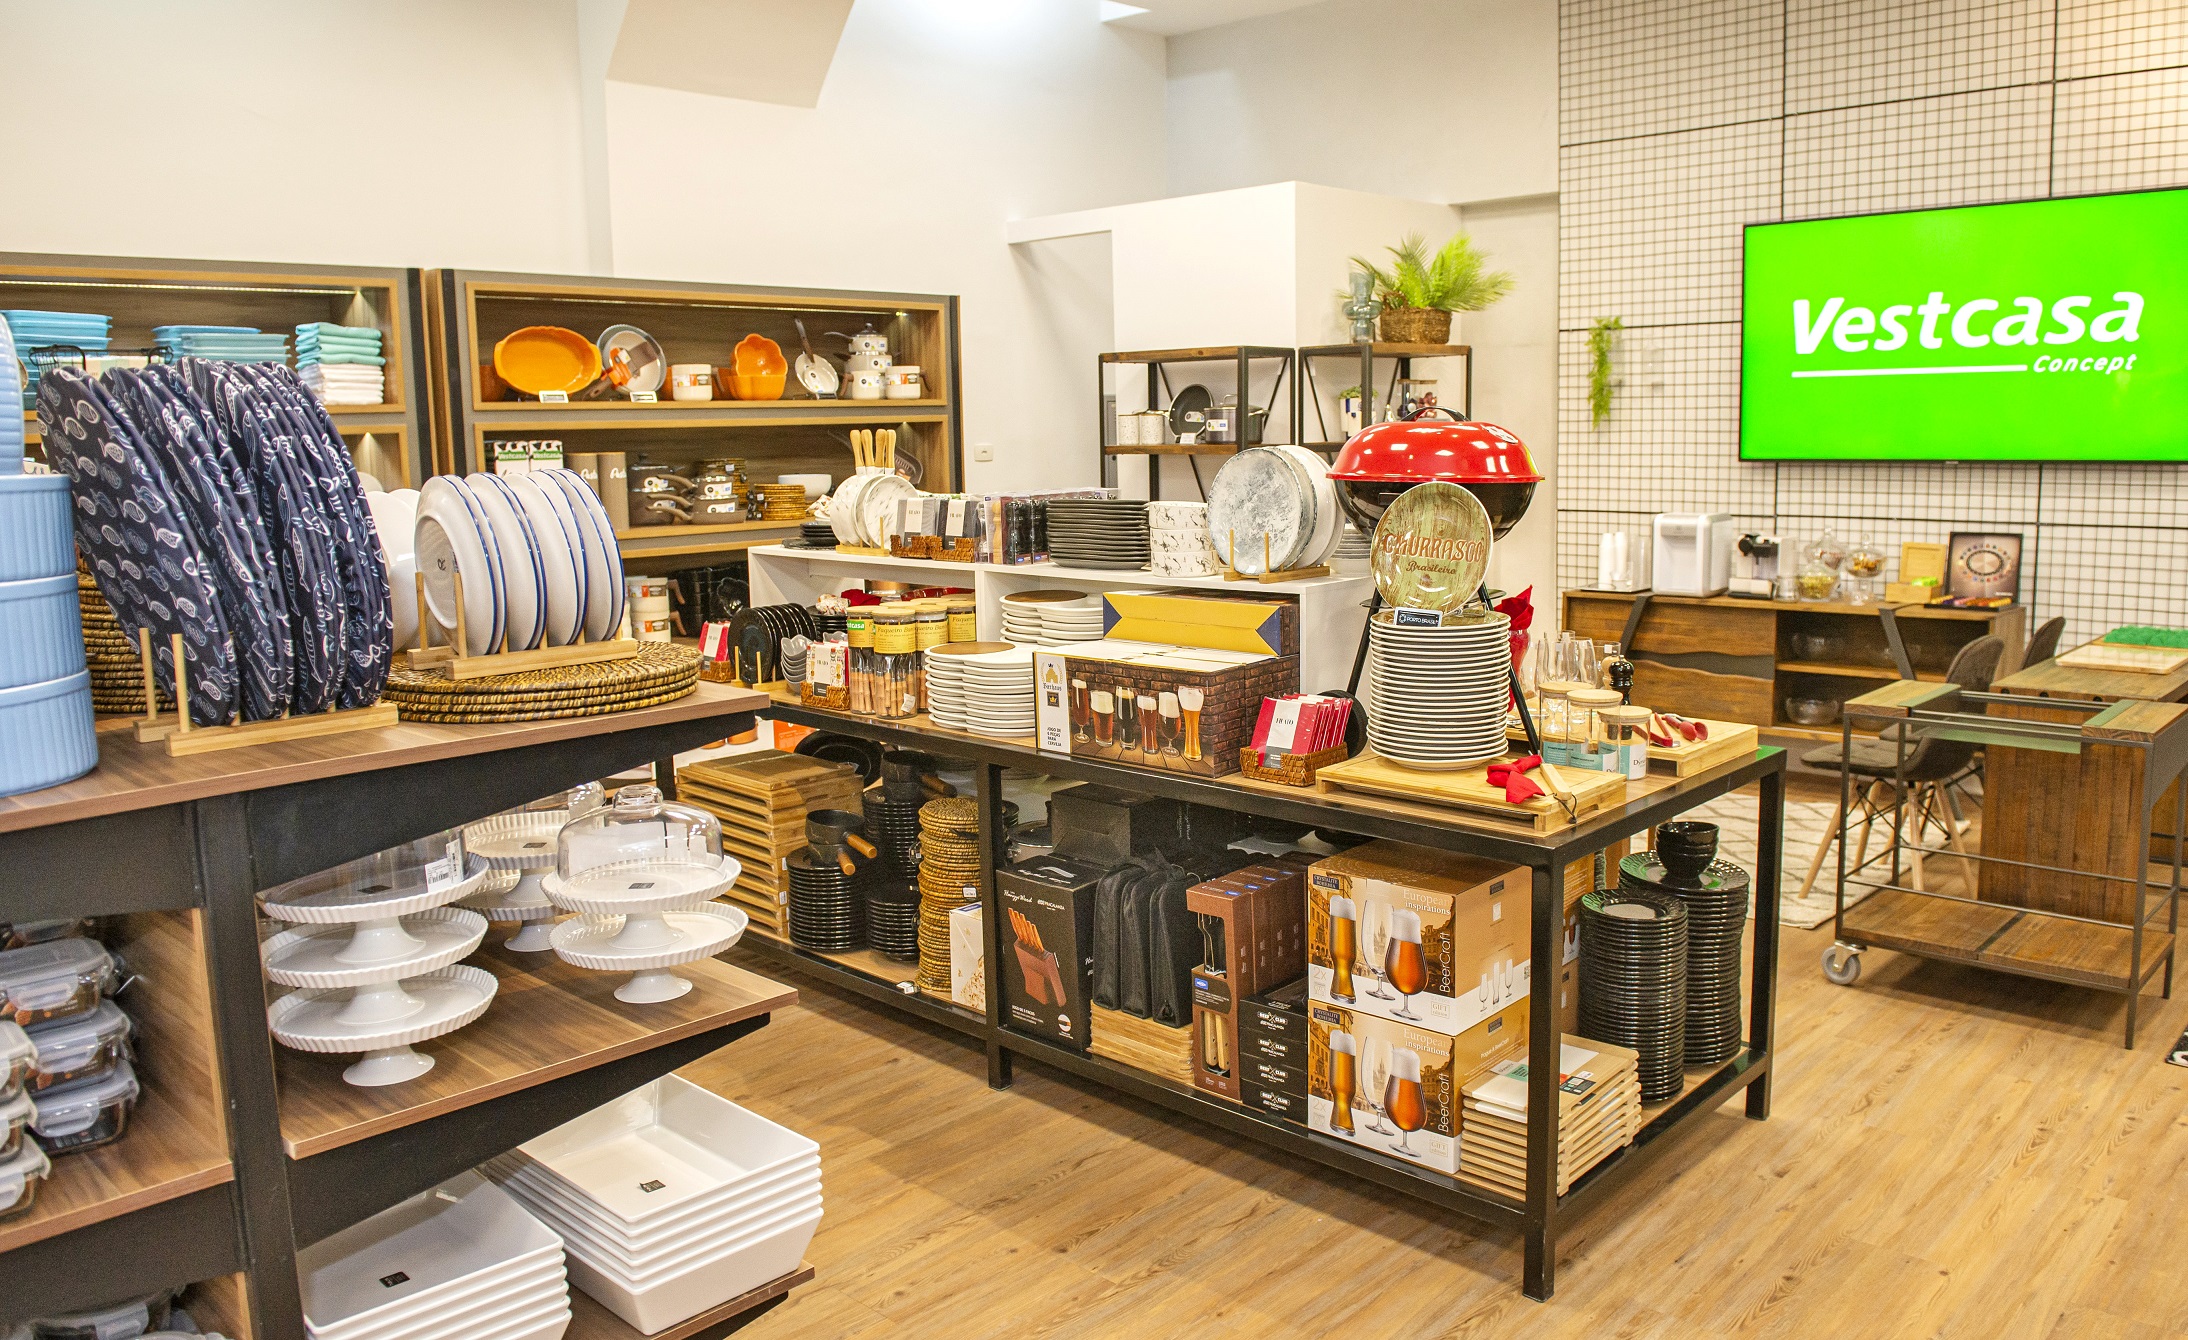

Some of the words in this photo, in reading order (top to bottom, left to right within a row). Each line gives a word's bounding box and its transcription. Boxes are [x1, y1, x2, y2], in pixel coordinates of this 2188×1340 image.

[1793, 291, 2145, 355] Vestcasa
[2033, 353, 2138, 375] Concept
[1382, 532, 1484, 563] CHURRASCO
[1405, 560, 1457, 575] Brasileiro
[1403, 889, 1451, 907] European
[1405, 901, 1451, 916] inspirations
[1439, 932, 1451, 993] BeerCraft
[1404, 1040, 1450, 1057] inspirations
[1438, 1073, 1450, 1133] BeerCraft
